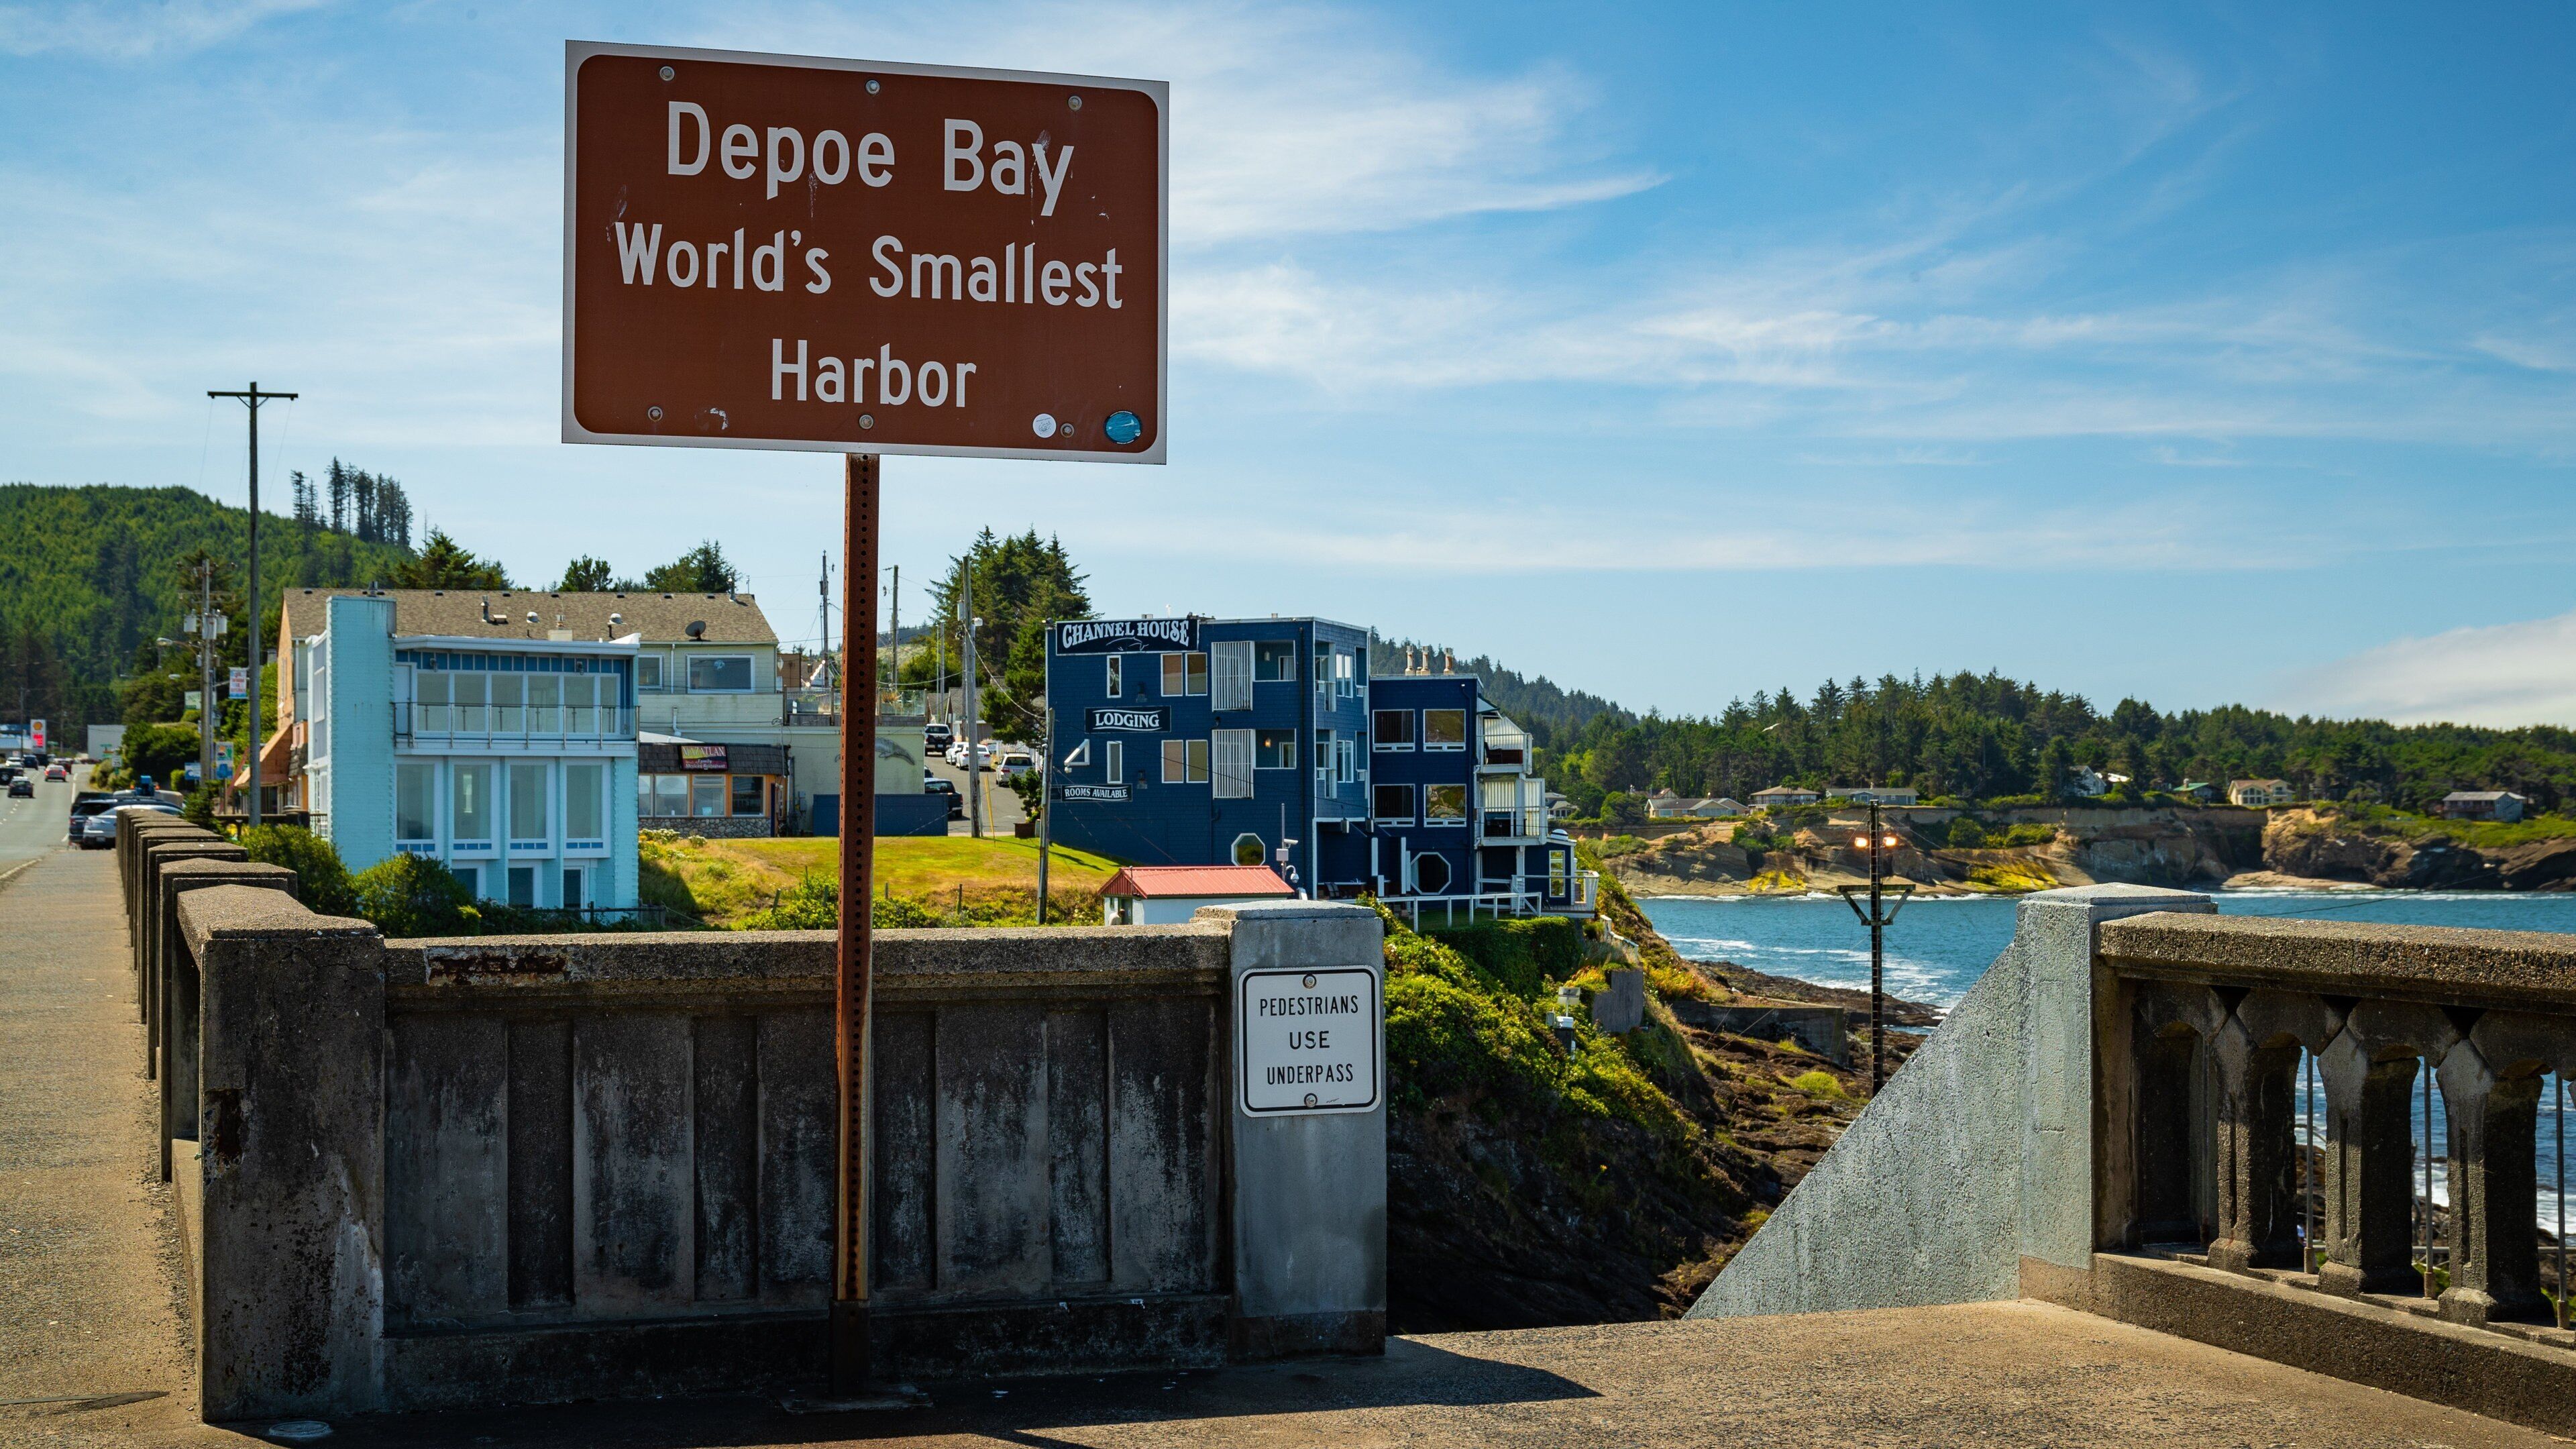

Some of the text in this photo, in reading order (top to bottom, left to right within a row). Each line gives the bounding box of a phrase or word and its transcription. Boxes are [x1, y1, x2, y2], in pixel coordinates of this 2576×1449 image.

[667, 101, 1075, 217] Depoe Bay
[614, 221, 1124, 310] World's Smallest
[771, 338, 977, 409] Harbor
[1063, 620, 1189, 649] CHANNEL HOUSE
[1095, 712, 1160, 728] LODGING
[1065, 788, 1128, 798] ROOMS AVAILABLE
[1260, 995, 1358, 1017] PEDESTRIANS
[1289, 1030, 1330, 1050] USE
[1267, 1063, 1354, 1085] UNDERPASS
